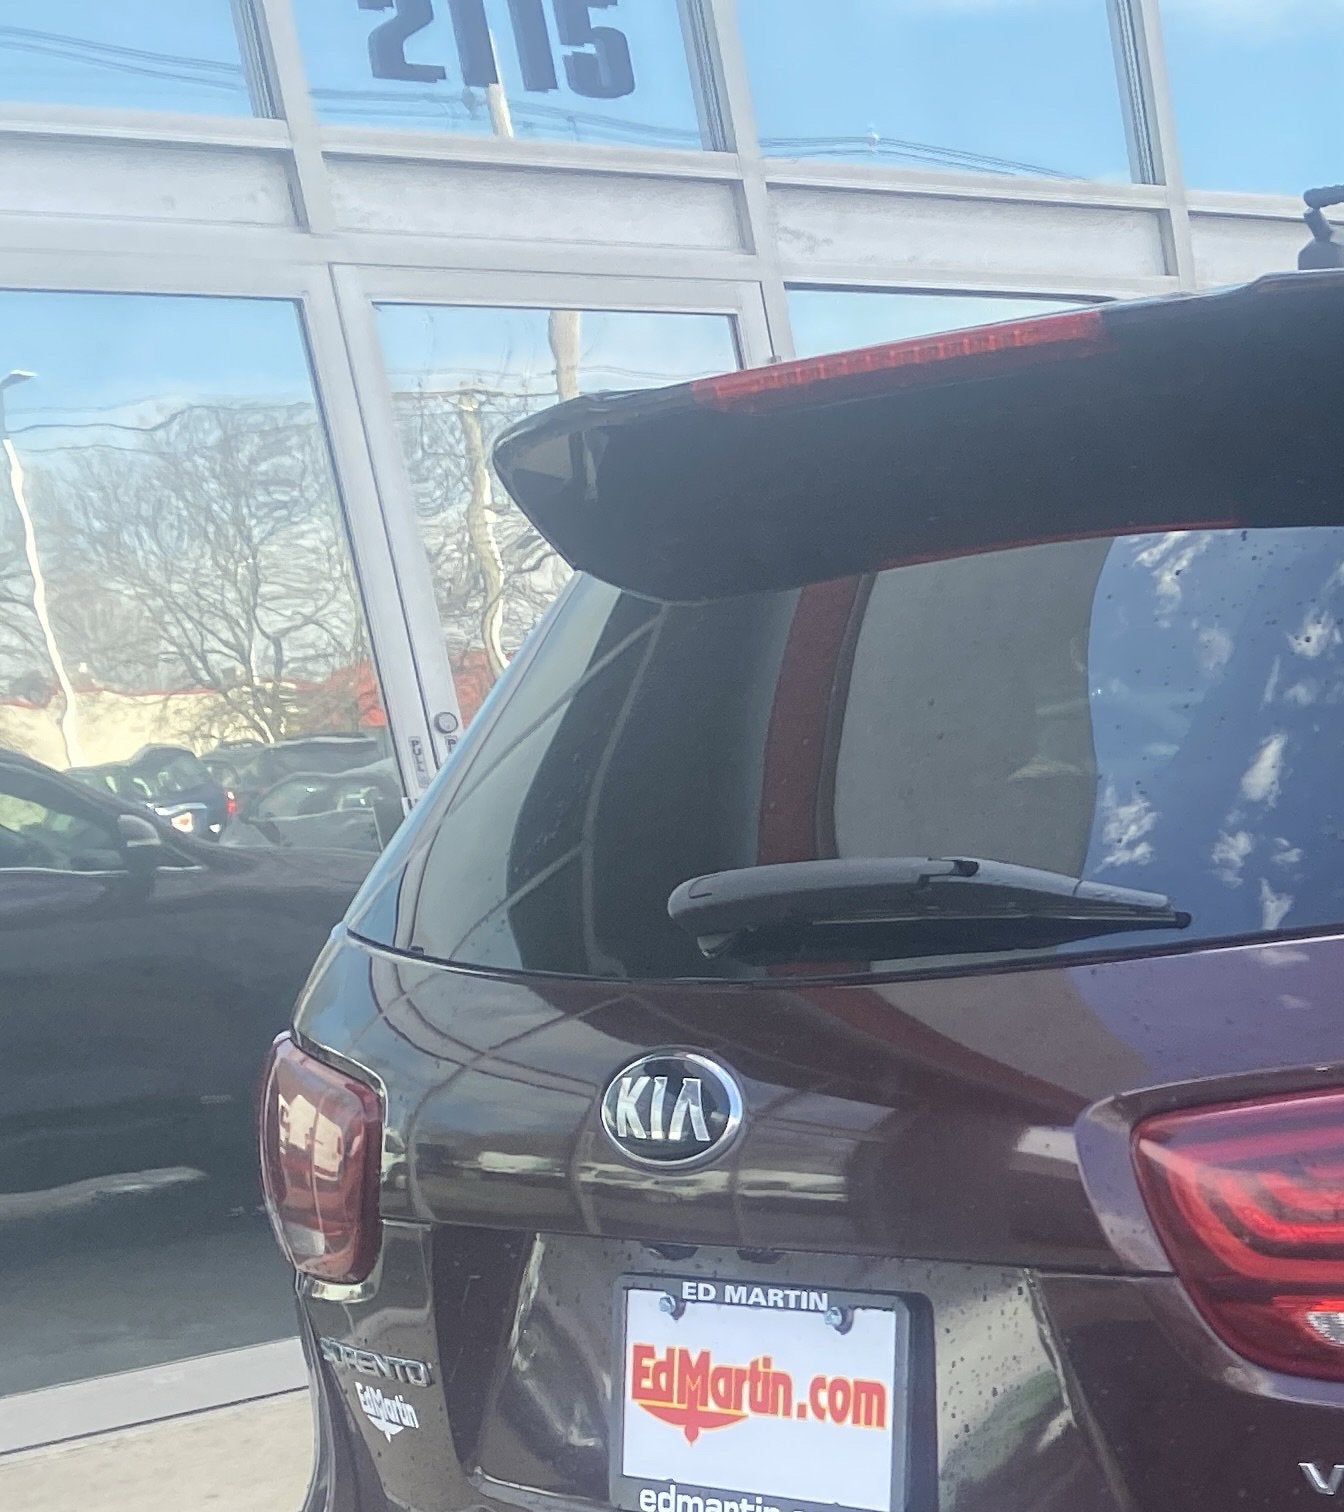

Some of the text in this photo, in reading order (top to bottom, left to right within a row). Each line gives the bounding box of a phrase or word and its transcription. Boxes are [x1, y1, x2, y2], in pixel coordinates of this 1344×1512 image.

[348, 0, 636, 99] 2115
[616, 1076, 711, 1141] KIA
[682, 1282, 828, 1312] ED MARTIN
[631, 1344, 887, 1430] EdMartin.com
